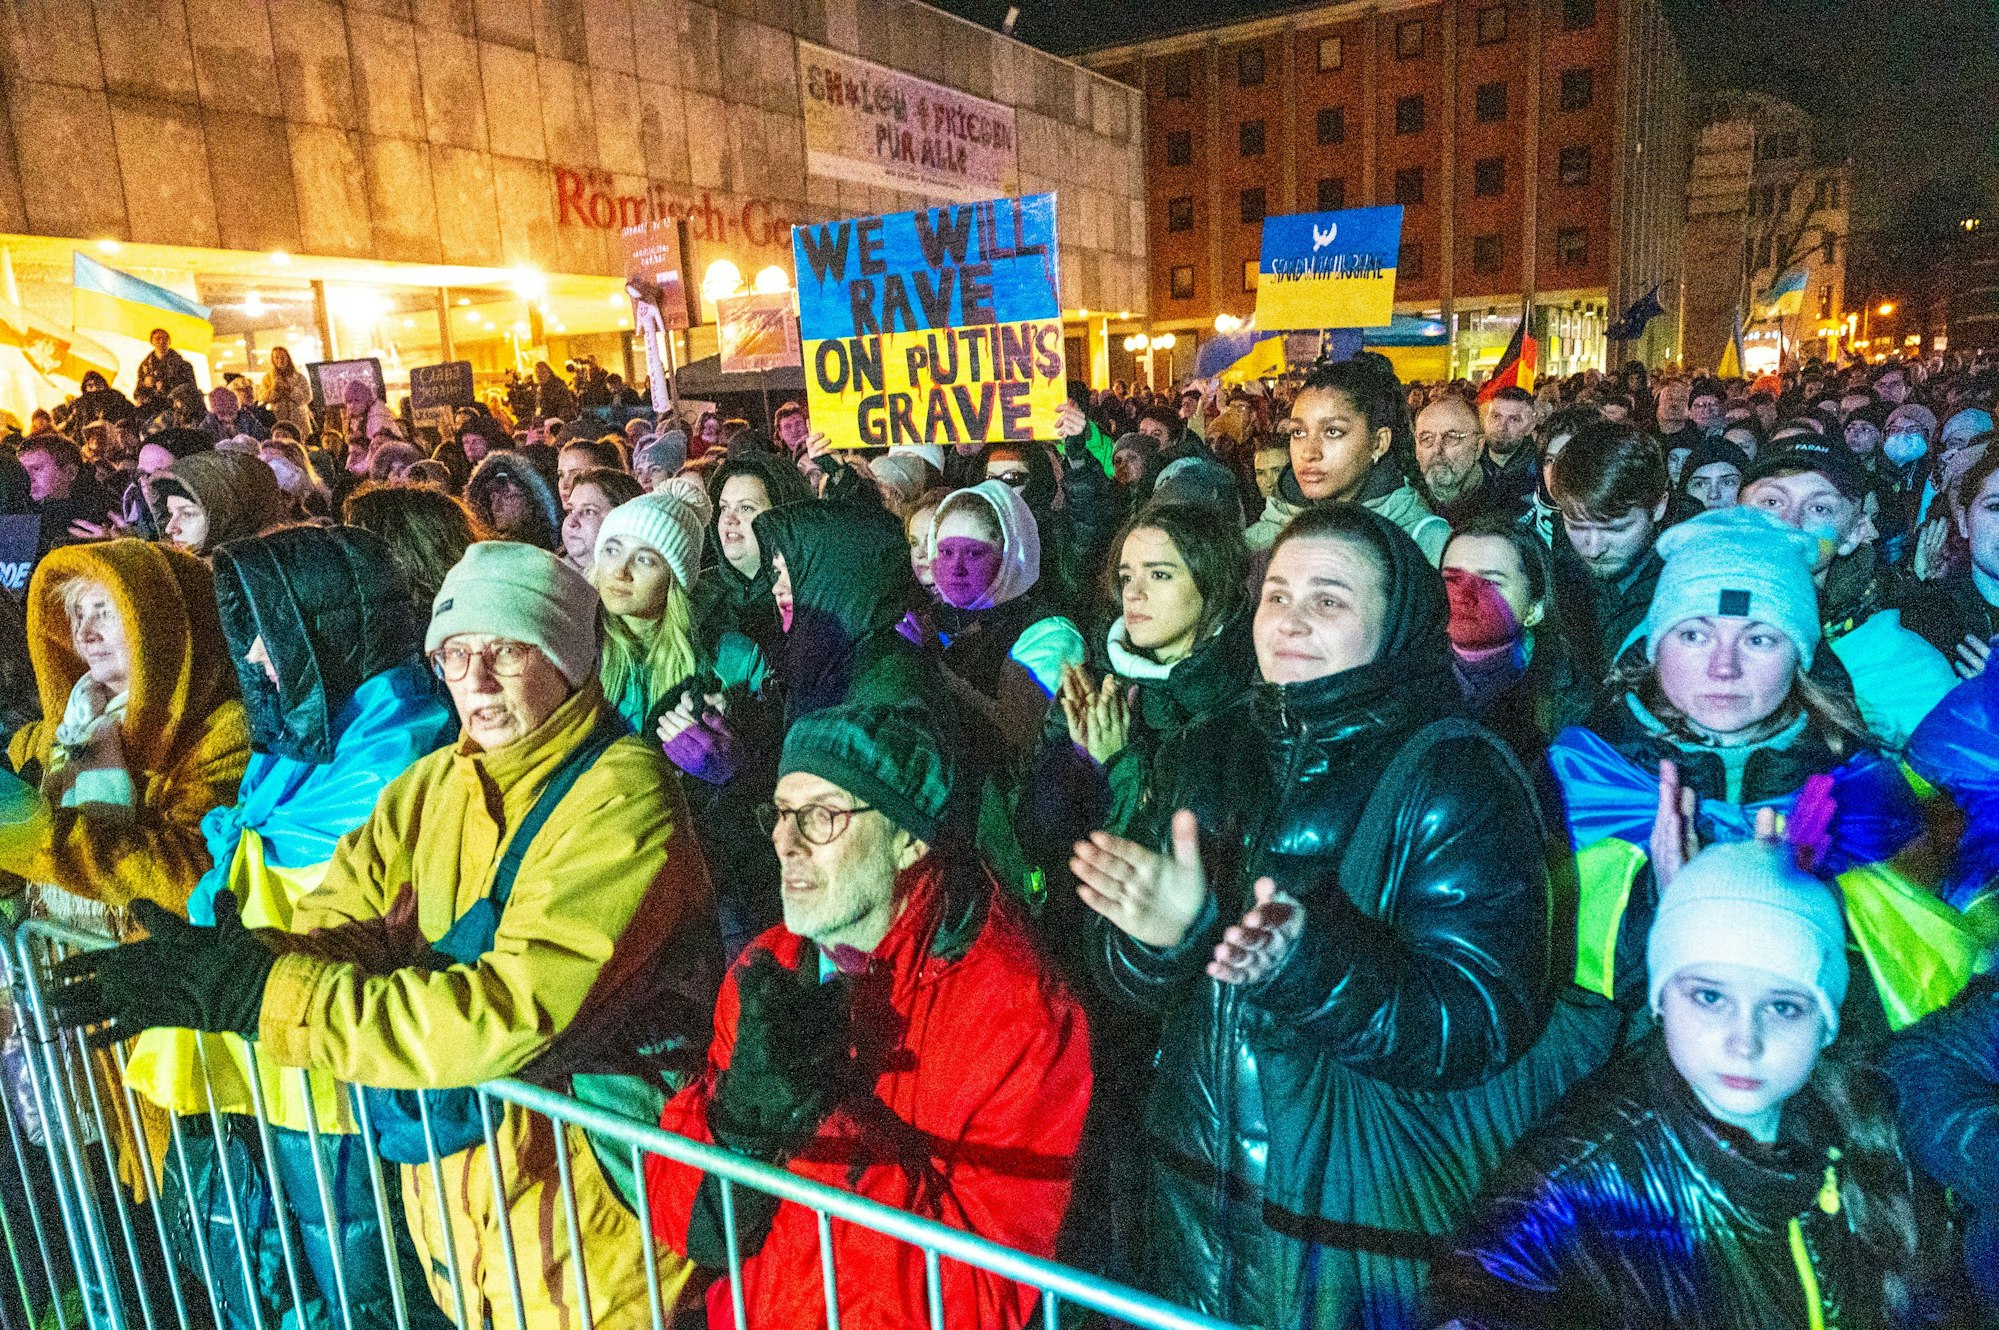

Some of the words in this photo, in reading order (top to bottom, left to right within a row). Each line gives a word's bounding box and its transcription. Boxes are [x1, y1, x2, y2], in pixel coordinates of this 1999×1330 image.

[798, 216, 886, 283] WE
[914, 199, 1049, 270] WILL
[850, 263, 996, 338] RAVE
[815, 335, 884, 394] ON
[905, 322, 1062, 387] PUTIN'S
[857, 381, 1034, 446] GRAVE
[1795, 443, 1829, 453] FARAH
